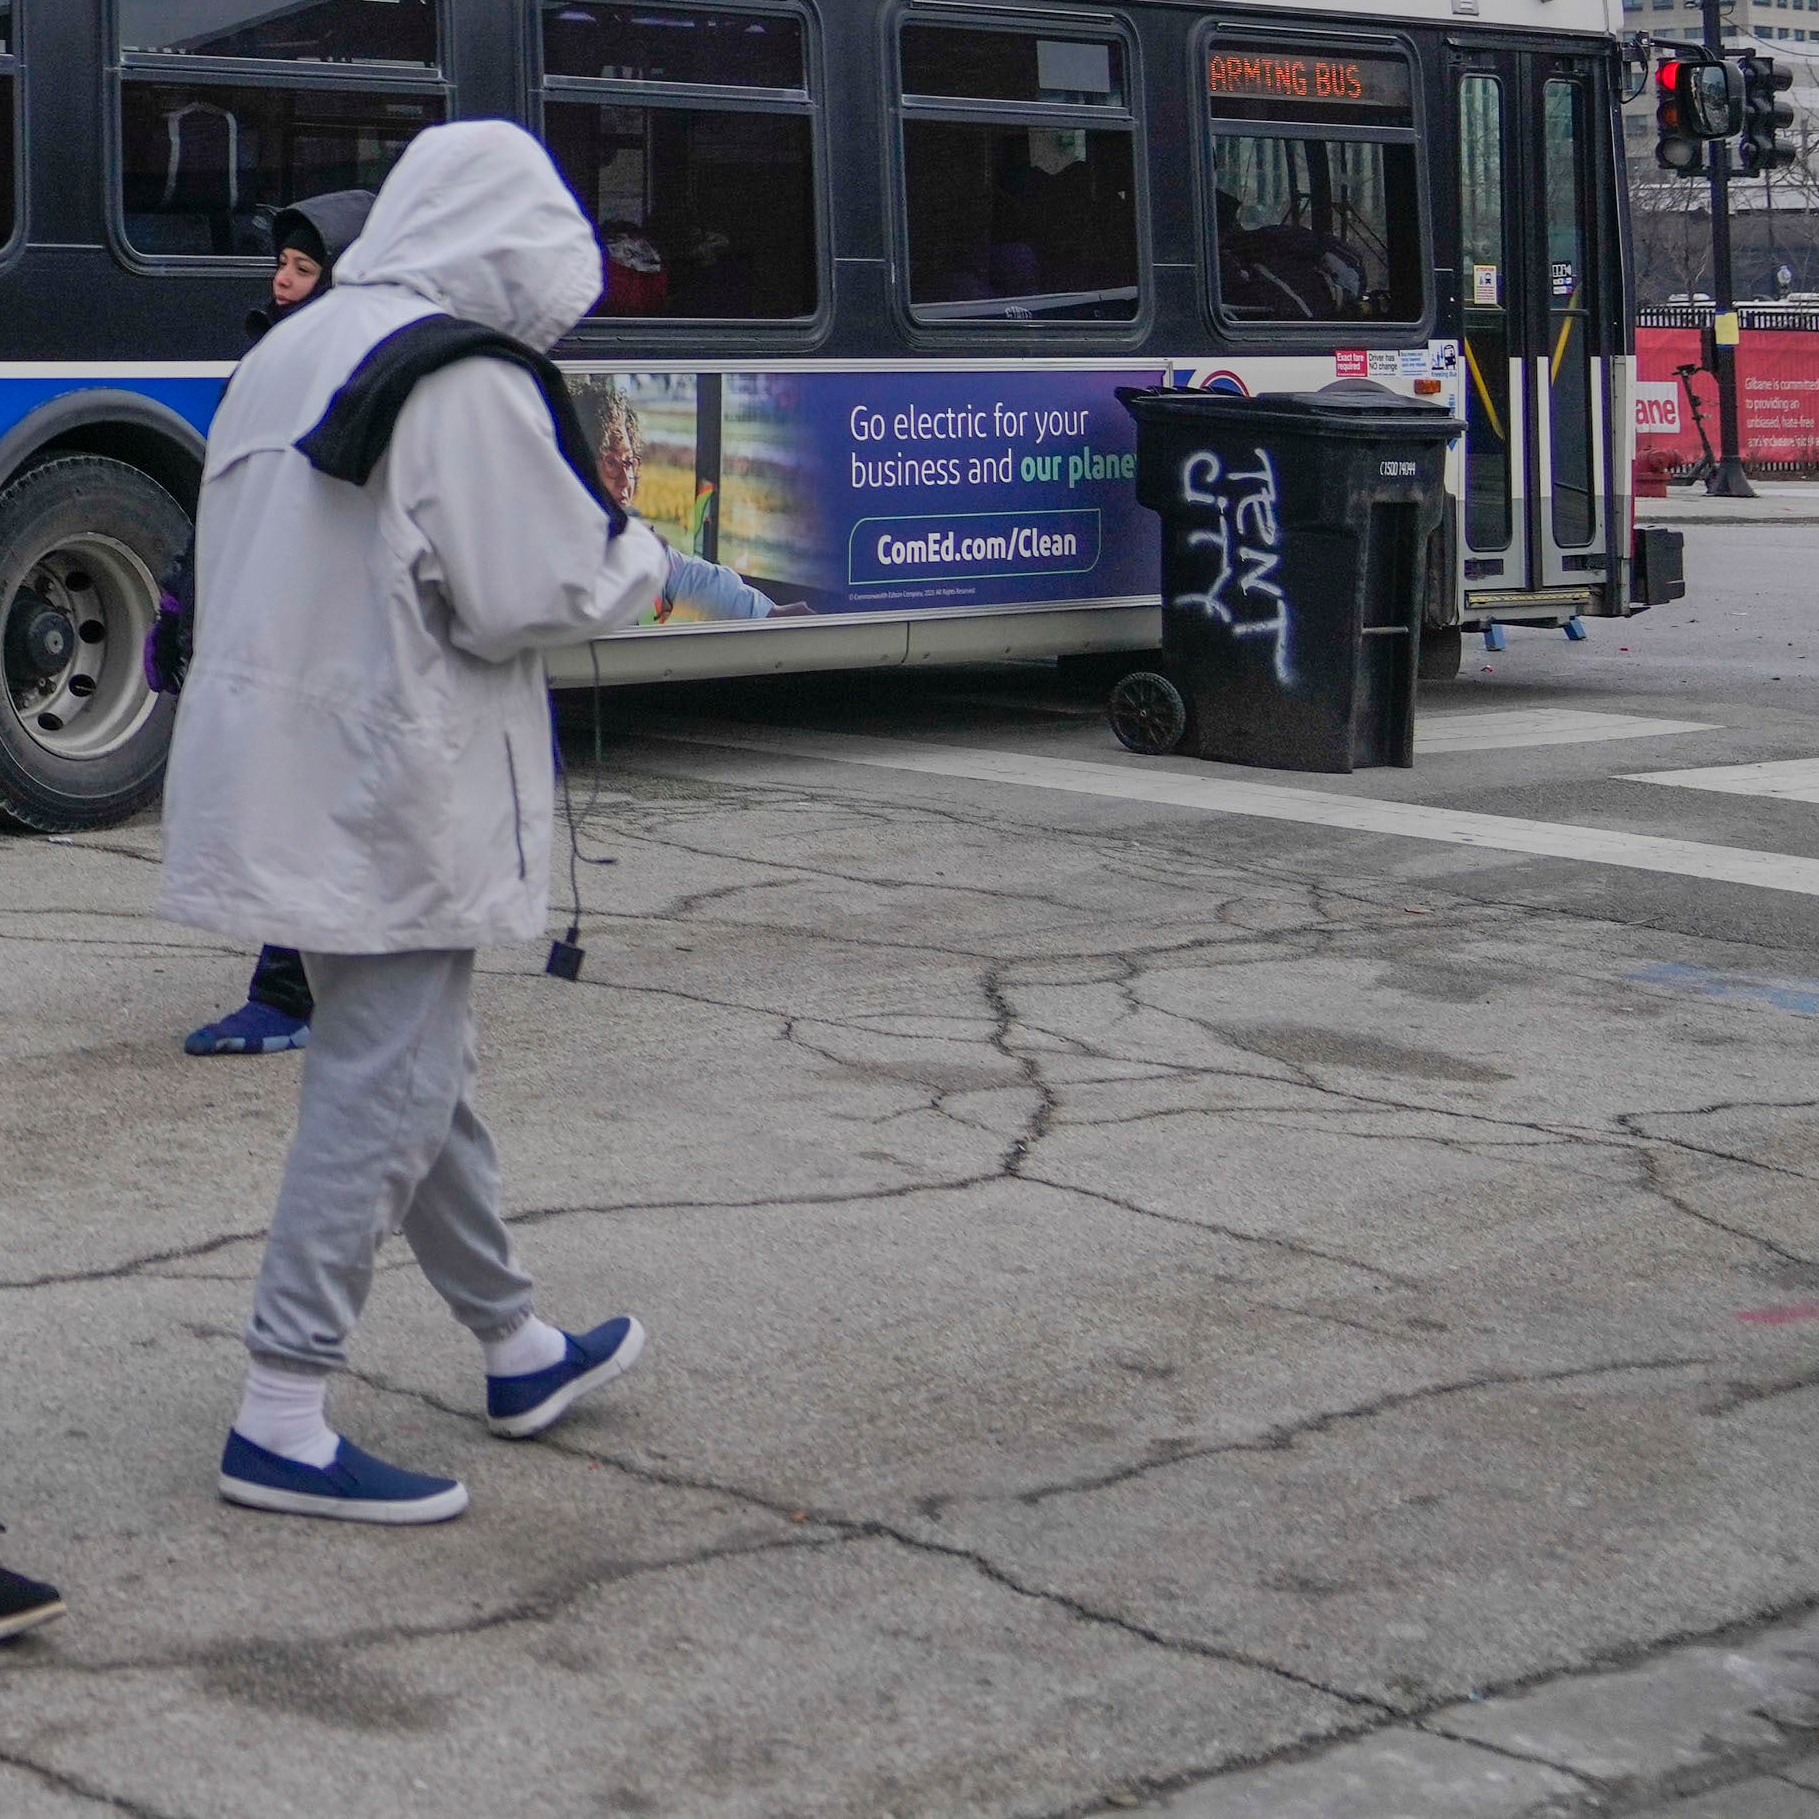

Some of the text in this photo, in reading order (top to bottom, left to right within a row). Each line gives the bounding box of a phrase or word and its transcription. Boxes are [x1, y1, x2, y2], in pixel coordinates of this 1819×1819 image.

[1315, 61, 1363, 100] BUS
[1337, 352, 1365, 361] Exact fare
[1368, 353, 1395, 361] Driver has
[1337, 362, 1361, 372] required
[1368, 362, 1398, 372] NO change
[1754, 397, 1789, 412] providing
[1789, 399, 1800, 409] an
[850, 402, 1089, 444] Go electric for your
[851, 446, 1138, 489] business and our plane
[877, 527, 1077, 566] ComEd.com/Clean
